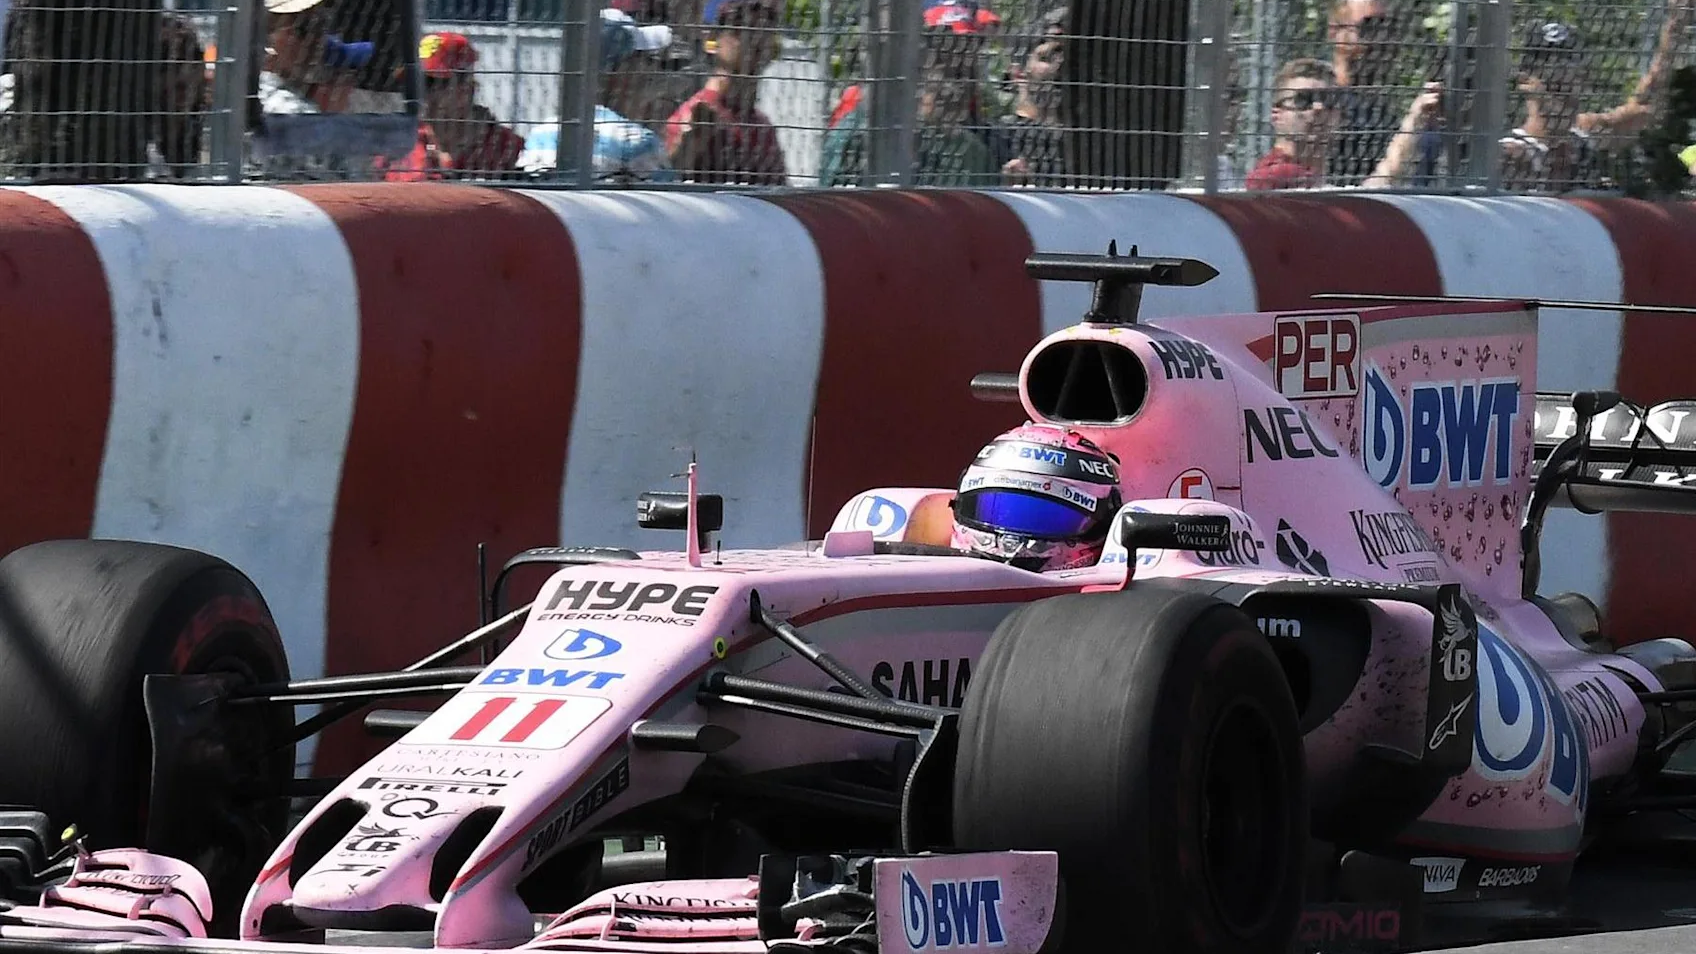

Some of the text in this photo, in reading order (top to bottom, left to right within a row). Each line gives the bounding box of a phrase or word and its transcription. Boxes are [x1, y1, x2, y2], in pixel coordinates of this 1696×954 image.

[1148, 339, 1224, 380] HYPE
[1277, 319, 1357, 393] PER
[1243, 407, 1339, 463] NEC
[1410, 383, 1520, 484] BWT
[1079, 459, 1114, 478] NEC
[1074, 491, 1096, 510] BWT
[1174, 523, 1220, 534] JOHNNIE
[1177, 535, 1220, 546] WALKER
[544, 580, 719, 616] HYPE
[537, 613, 697, 627] ENERGY DRINKS
[479, 668, 625, 689] BWT
[451, 697, 568, 743] 11
[377, 764, 523, 779] URALKALI
[357, 777, 508, 797] PIRELLI
[931, 880, 1004, 947] BWT
